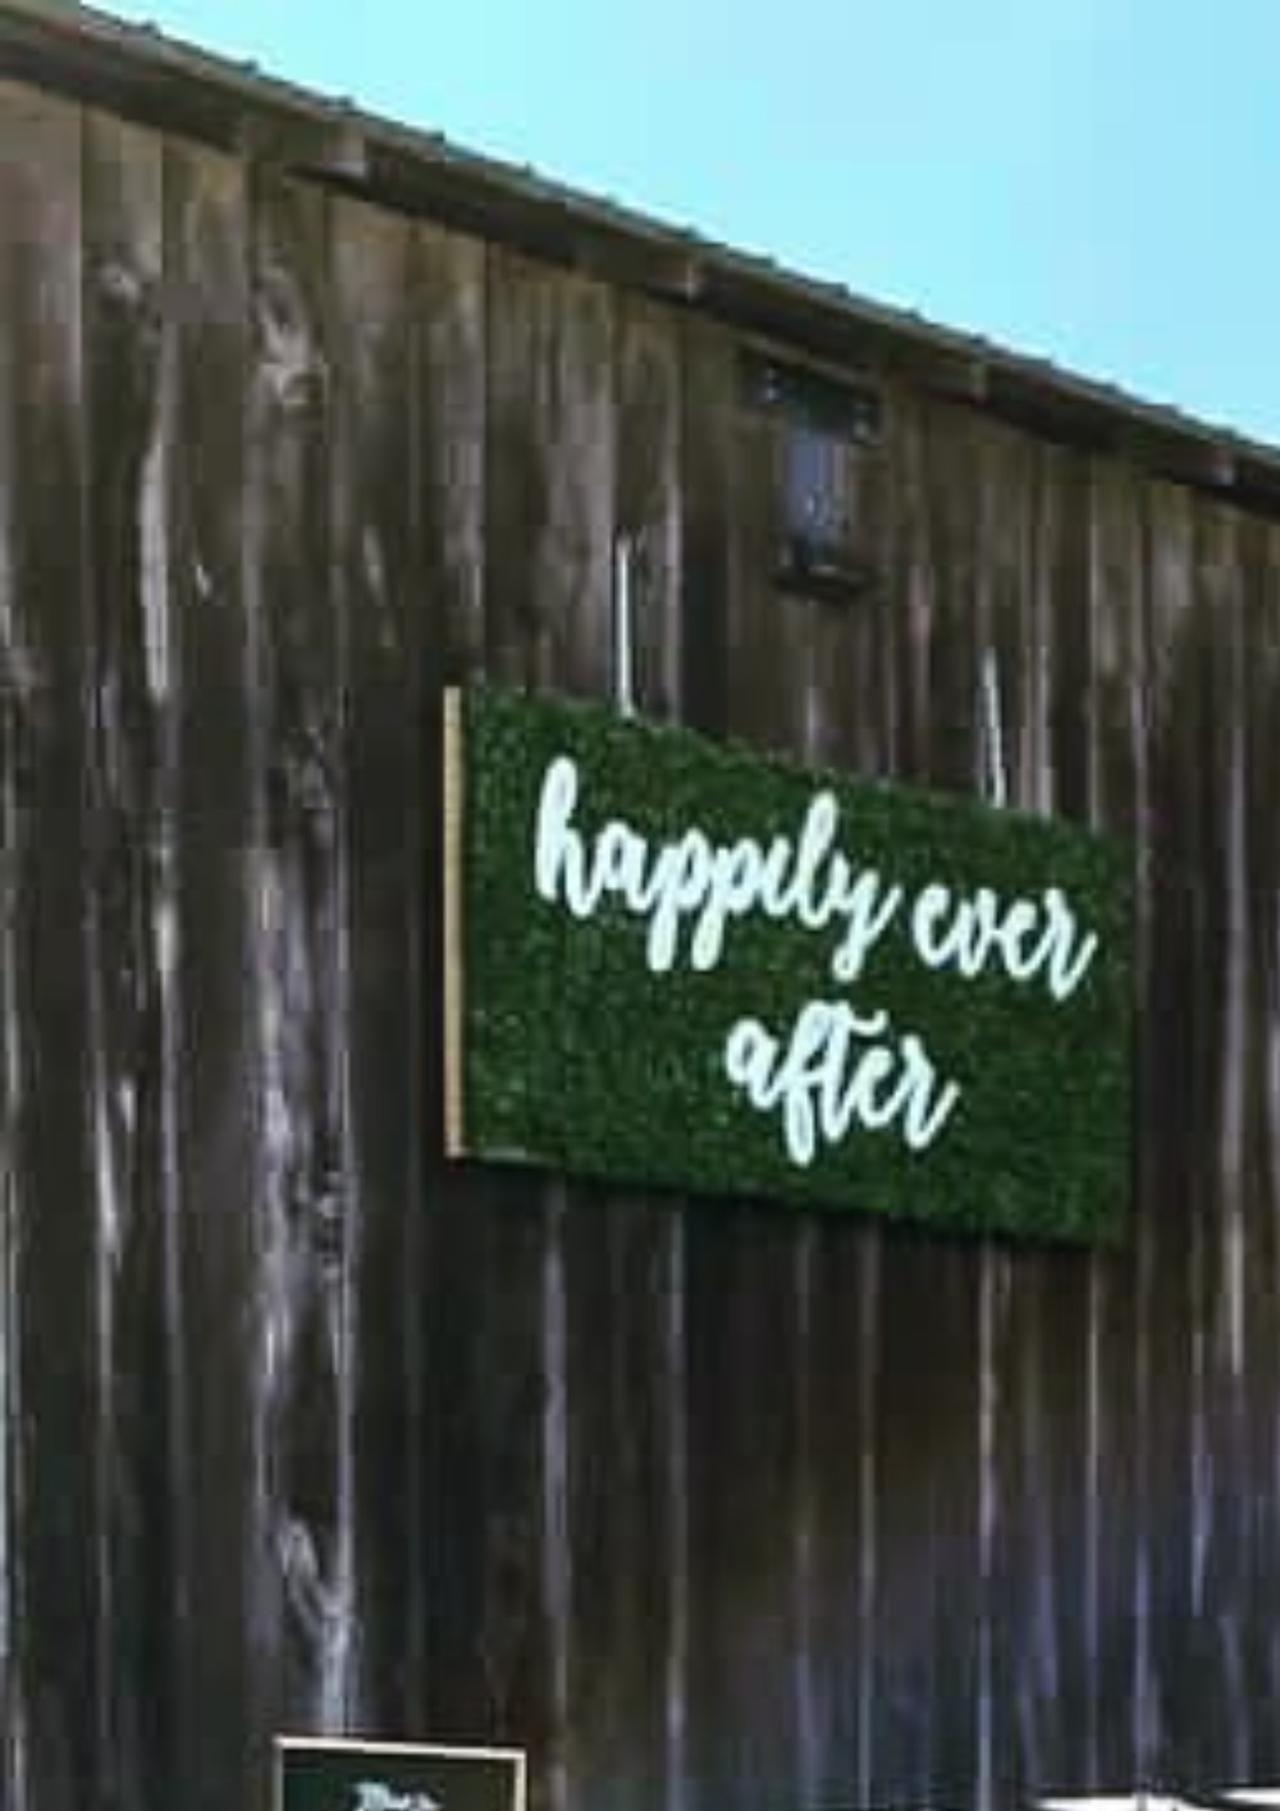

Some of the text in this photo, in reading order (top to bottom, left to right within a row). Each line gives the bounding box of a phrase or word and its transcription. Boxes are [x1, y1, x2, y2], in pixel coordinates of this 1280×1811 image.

[535, 756, 1098, 999] happily ever
[726, 1001, 960, 1165] after
